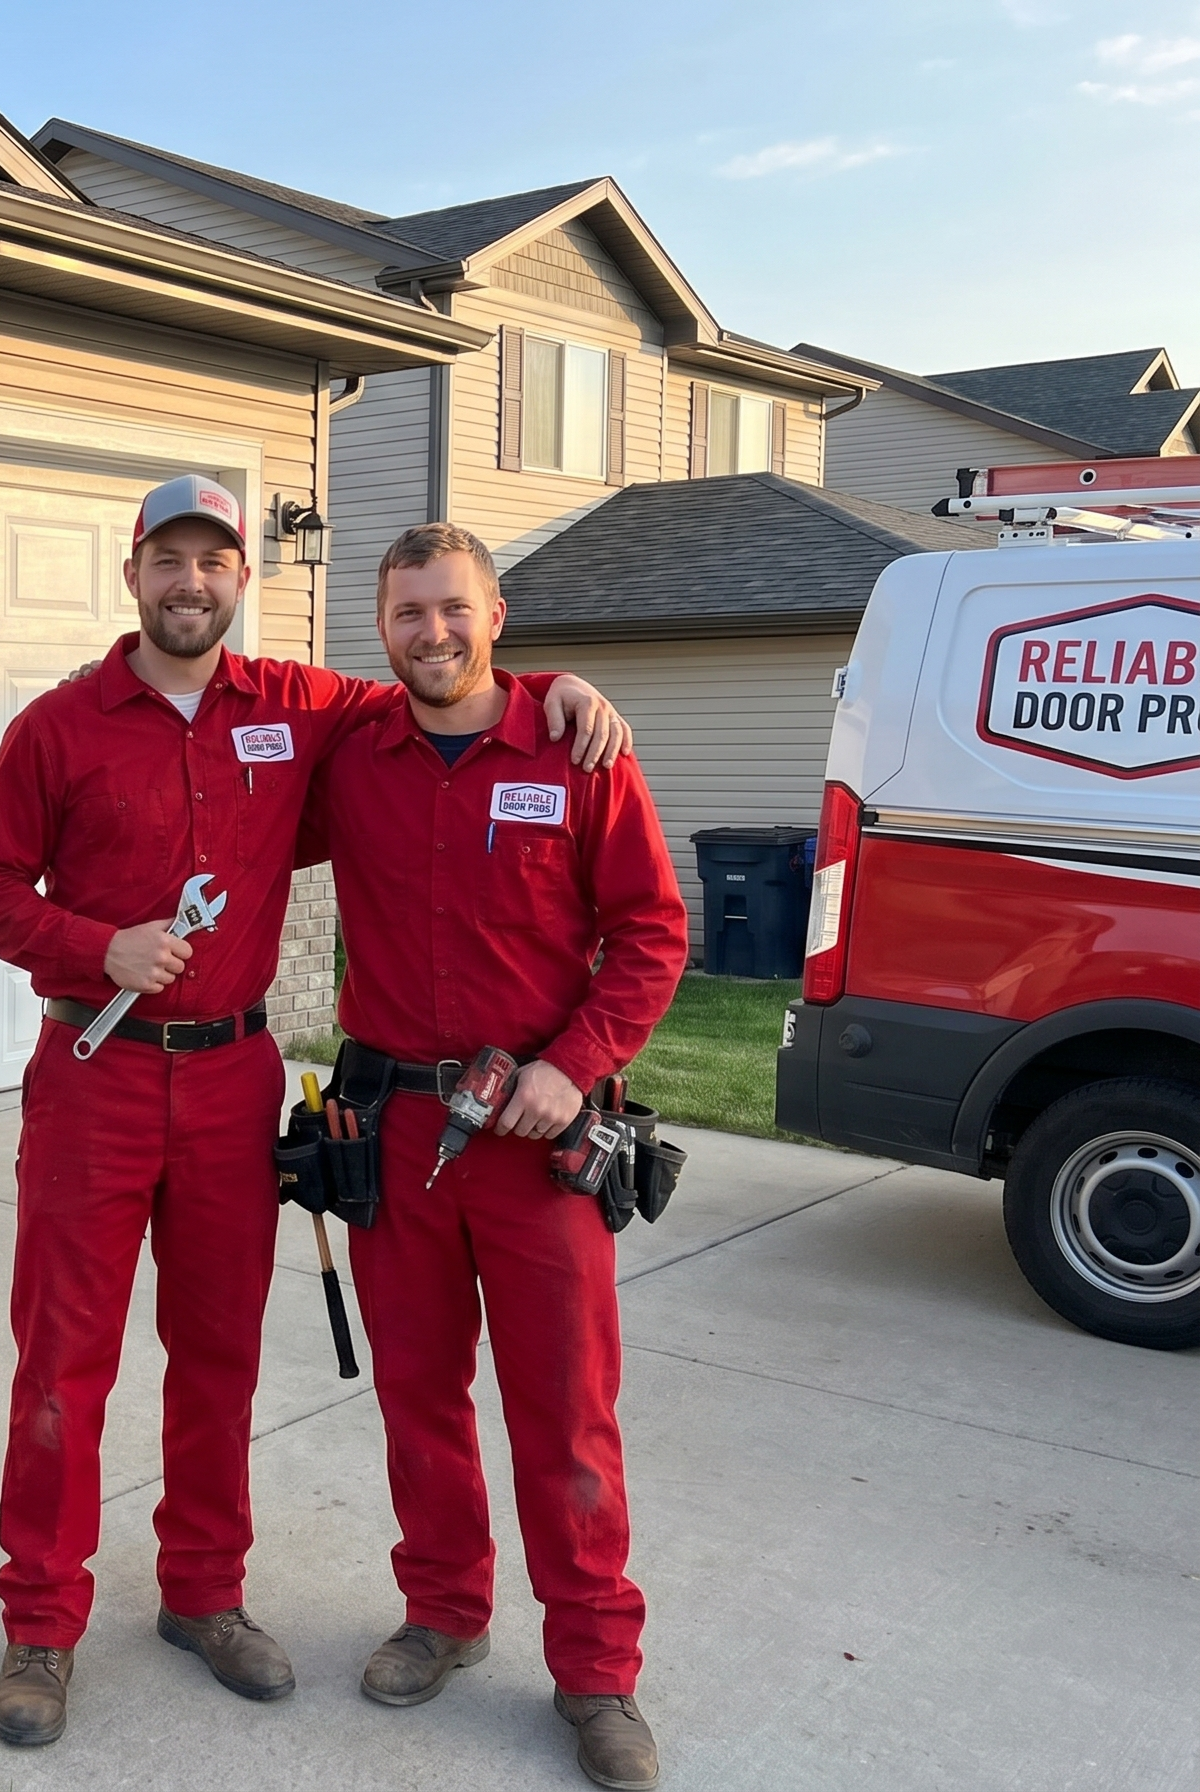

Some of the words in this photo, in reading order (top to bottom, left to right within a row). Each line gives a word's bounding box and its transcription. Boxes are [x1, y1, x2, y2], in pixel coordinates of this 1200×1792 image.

[1012, 691, 1124, 732] DOOR
[1137, 693, 1200, 735] PR
[504, 793, 551, 804] RELIABLE
